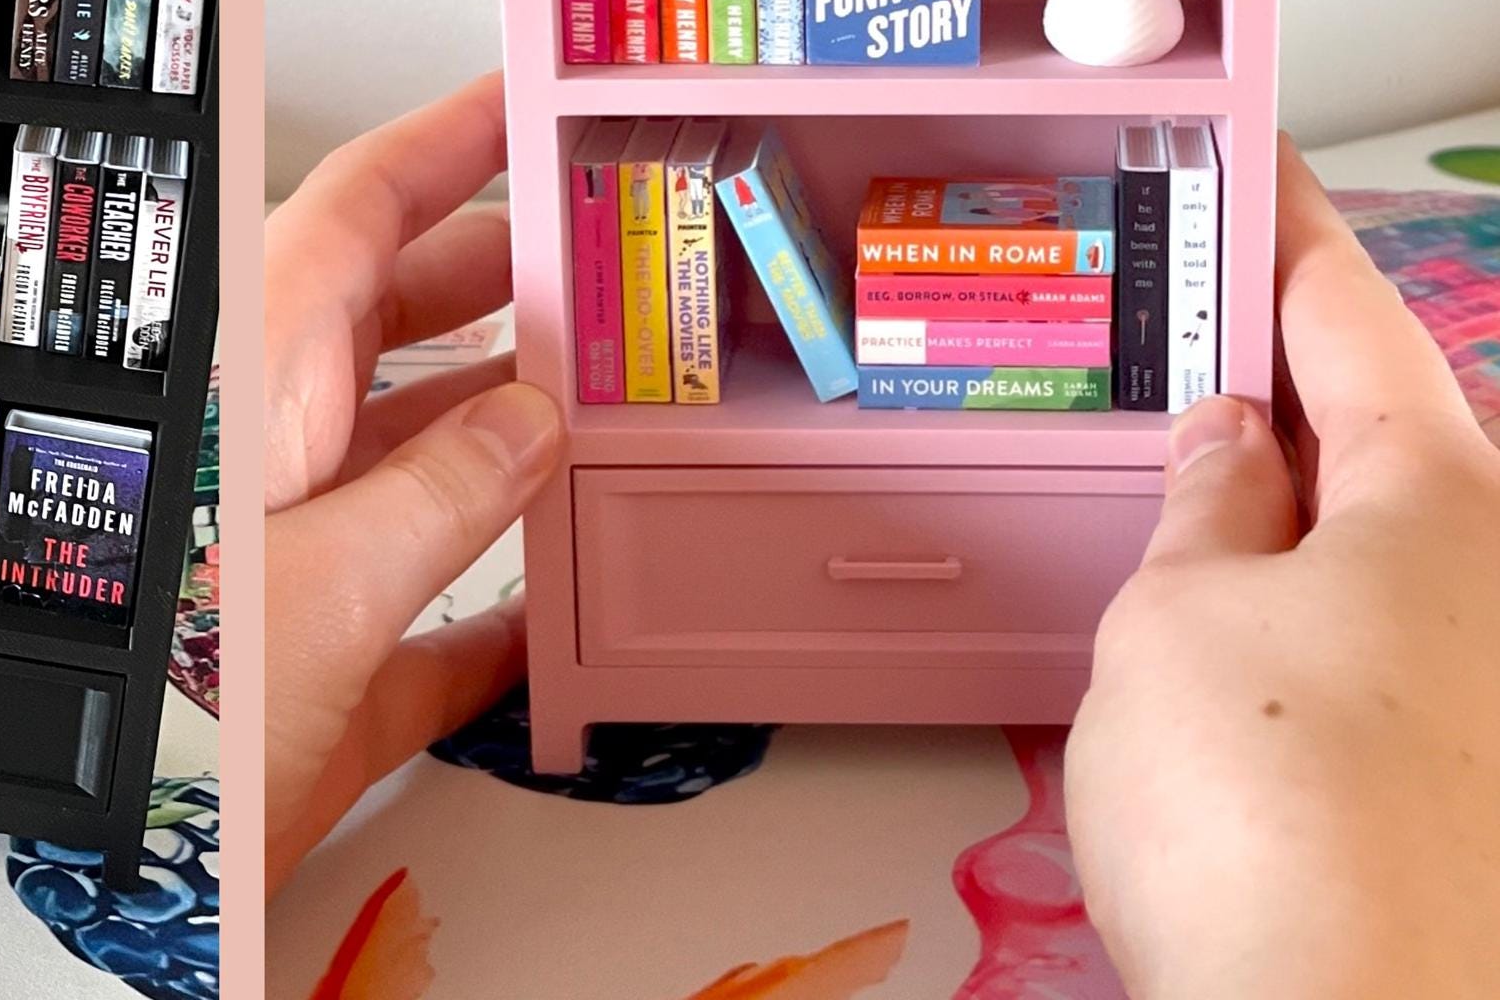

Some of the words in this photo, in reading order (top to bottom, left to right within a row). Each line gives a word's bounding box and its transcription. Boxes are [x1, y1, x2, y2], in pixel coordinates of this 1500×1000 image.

[676, 9, 697, 62] HENRY
[17, 173, 50, 254] BOYFRIEND
[56, 183, 94, 264] COWORKER
[99, 192, 136, 263] TEACHER
[152, 199, 175, 264] NEVER
[678, 259, 691, 290] THE
[862, 244, 939, 262] WHEN
[950, 245, 976, 263] IN
[989, 245, 1061, 264] ROME
[147, 267, 170, 299] LIE
[695, 251, 710, 329] NOTHING
[679, 295, 694, 362] MOVIES
[697, 334, 712, 370] LIKE
[872, 379, 894, 394] IN
[902, 379, 959, 396] YOUR
[967, 380, 1053, 397] DREAMS
[31, 469, 115, 505] FREIDA
[8, 492, 134, 536] McFADDEN
[44, 538, 89, 568] THE
[1, 559, 125, 605] INTRUDER
